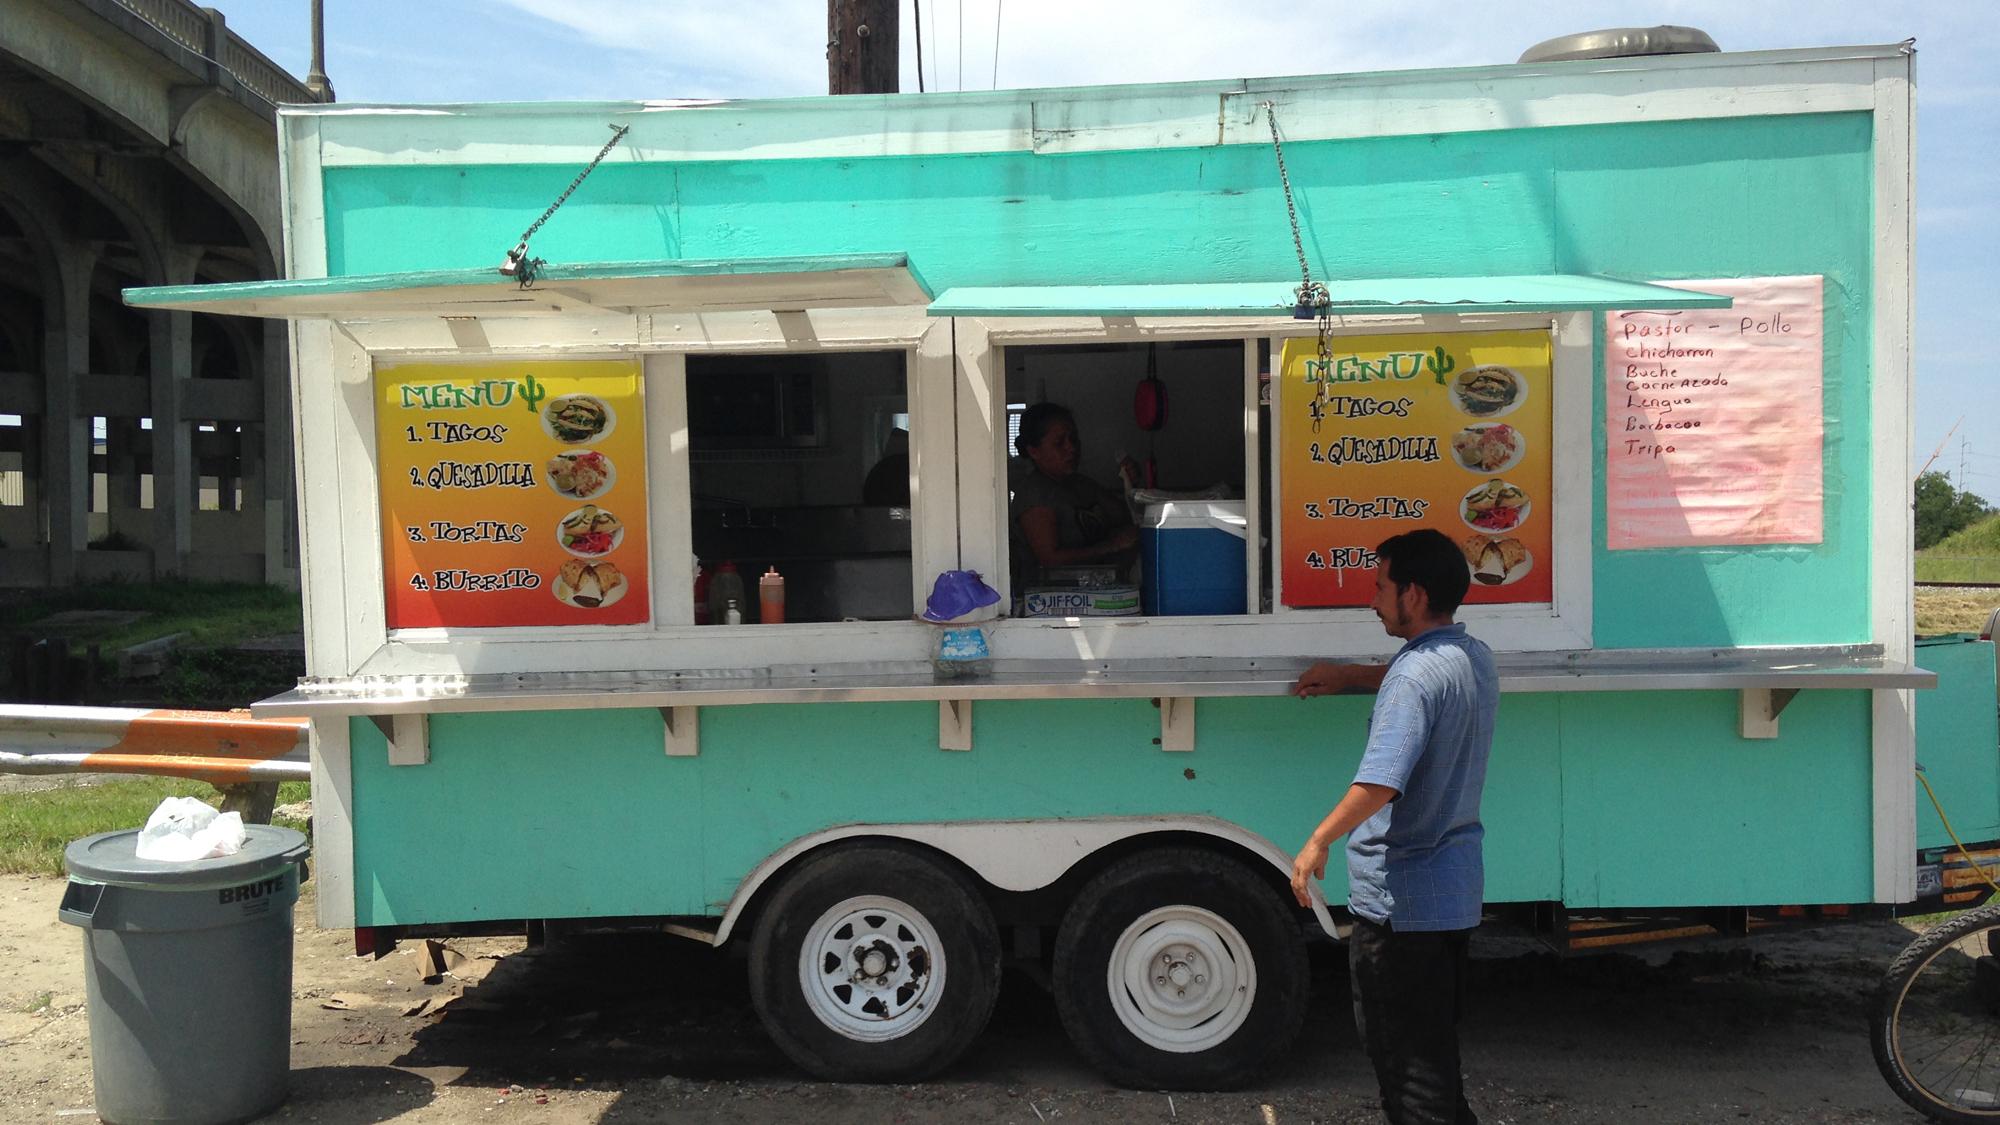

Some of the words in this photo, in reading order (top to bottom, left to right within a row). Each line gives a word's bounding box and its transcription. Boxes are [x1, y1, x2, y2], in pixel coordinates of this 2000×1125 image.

[1740, 312, 1792, 335] Pollo
[1304, 353, 1425, 384] MENU
[1626, 362, 1678, 379] Buche
[401, 381, 516, 411] MENU
[1625, 380, 1676, 392] Carne
[1309, 400, 1325, 418] 1.
[1329, 396, 1414, 418] TACOS
[1627, 396, 1692, 415] Lengua
[407, 425, 423, 443] 1.
[427, 421, 508, 444] TACOS
[1624, 415, 1702, 433] Barbacoa
[1309, 443, 1325, 463] 2.
[1328, 436, 1440, 465] QUESADILLA
[1624, 439, 1677, 460] Tripa
[410, 469, 425, 486] 2.
[427, 461, 536, 490] QUESADILLA
[1305, 503, 1324, 519] 3.
[1328, 497, 1429, 520] TORTAS
[408, 526, 427, 542] 3.
[430, 521, 527, 544] TORTAS
[409, 574, 429, 591] 4.
[433, 569, 540, 592] BURRITO
[219, 874, 286, 905] BRUTE
